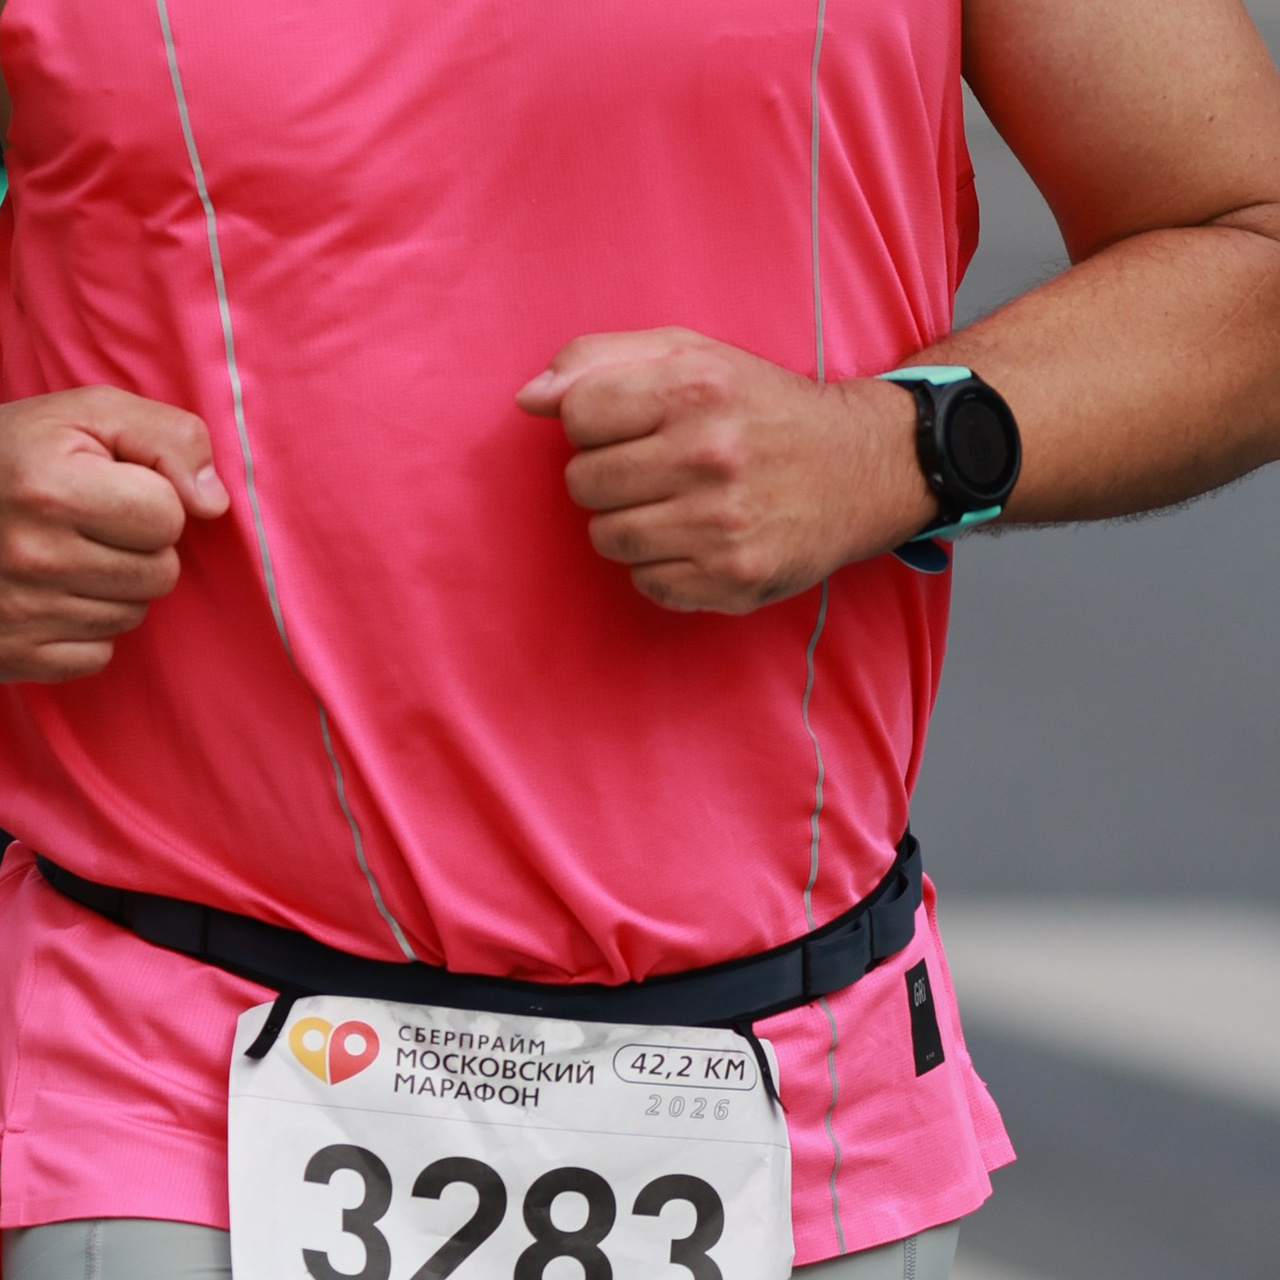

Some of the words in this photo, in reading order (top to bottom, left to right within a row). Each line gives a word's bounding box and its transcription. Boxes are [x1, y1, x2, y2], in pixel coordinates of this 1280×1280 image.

[398, 1025, 545, 1055] СБЕРПРАЙМ
[396, 1047, 595, 1084] МОСКОВСКИЙ
[630, 1053, 693, 1080] 42,2
[394, 1073, 540, 1107] МАРАФОН
[645, 1094, 730, 1120] 2026
